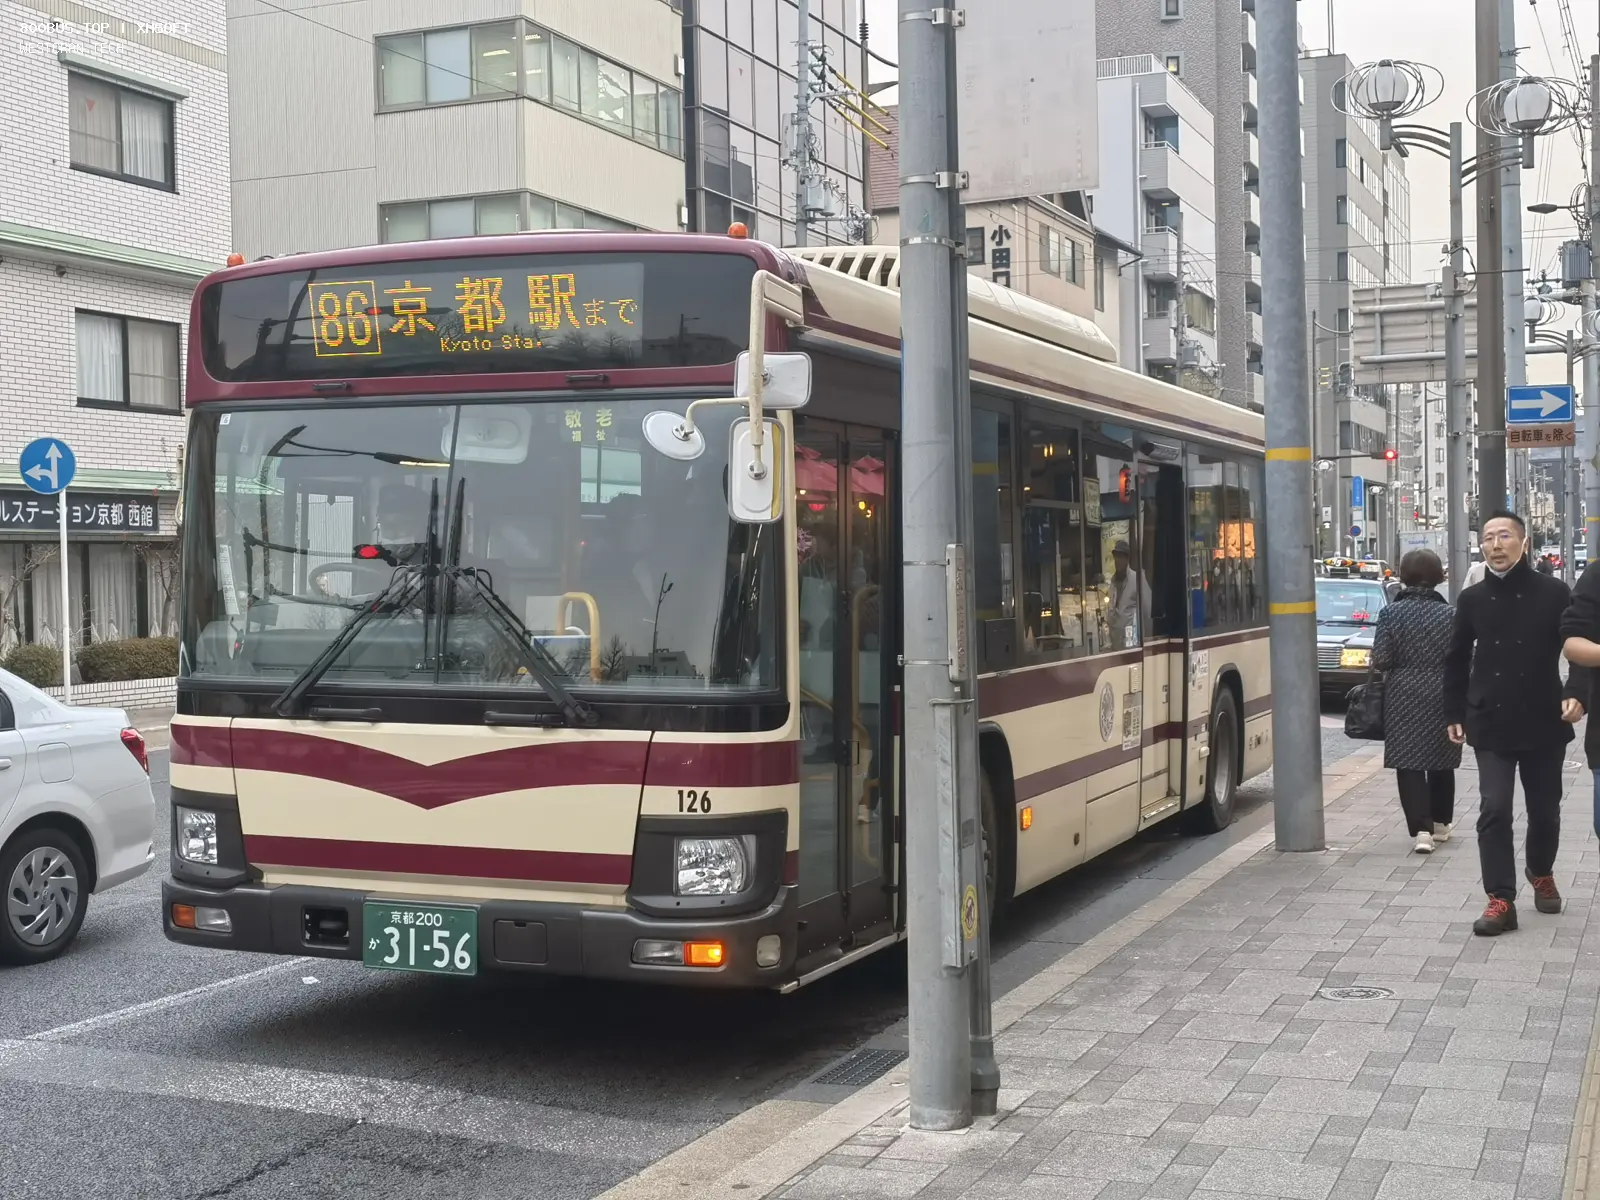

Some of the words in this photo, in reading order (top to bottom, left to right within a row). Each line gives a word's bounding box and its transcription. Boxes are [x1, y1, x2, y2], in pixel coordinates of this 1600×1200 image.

[318, 290, 372, 347] 86
[440, 335, 492, 352] Kyoto
[1510, 428, 1573, 443] 自転車を除く
[677, 789, 712, 814] 126
[368, 937, 380, 951] か
[383, 926, 471, 970] 31-56
